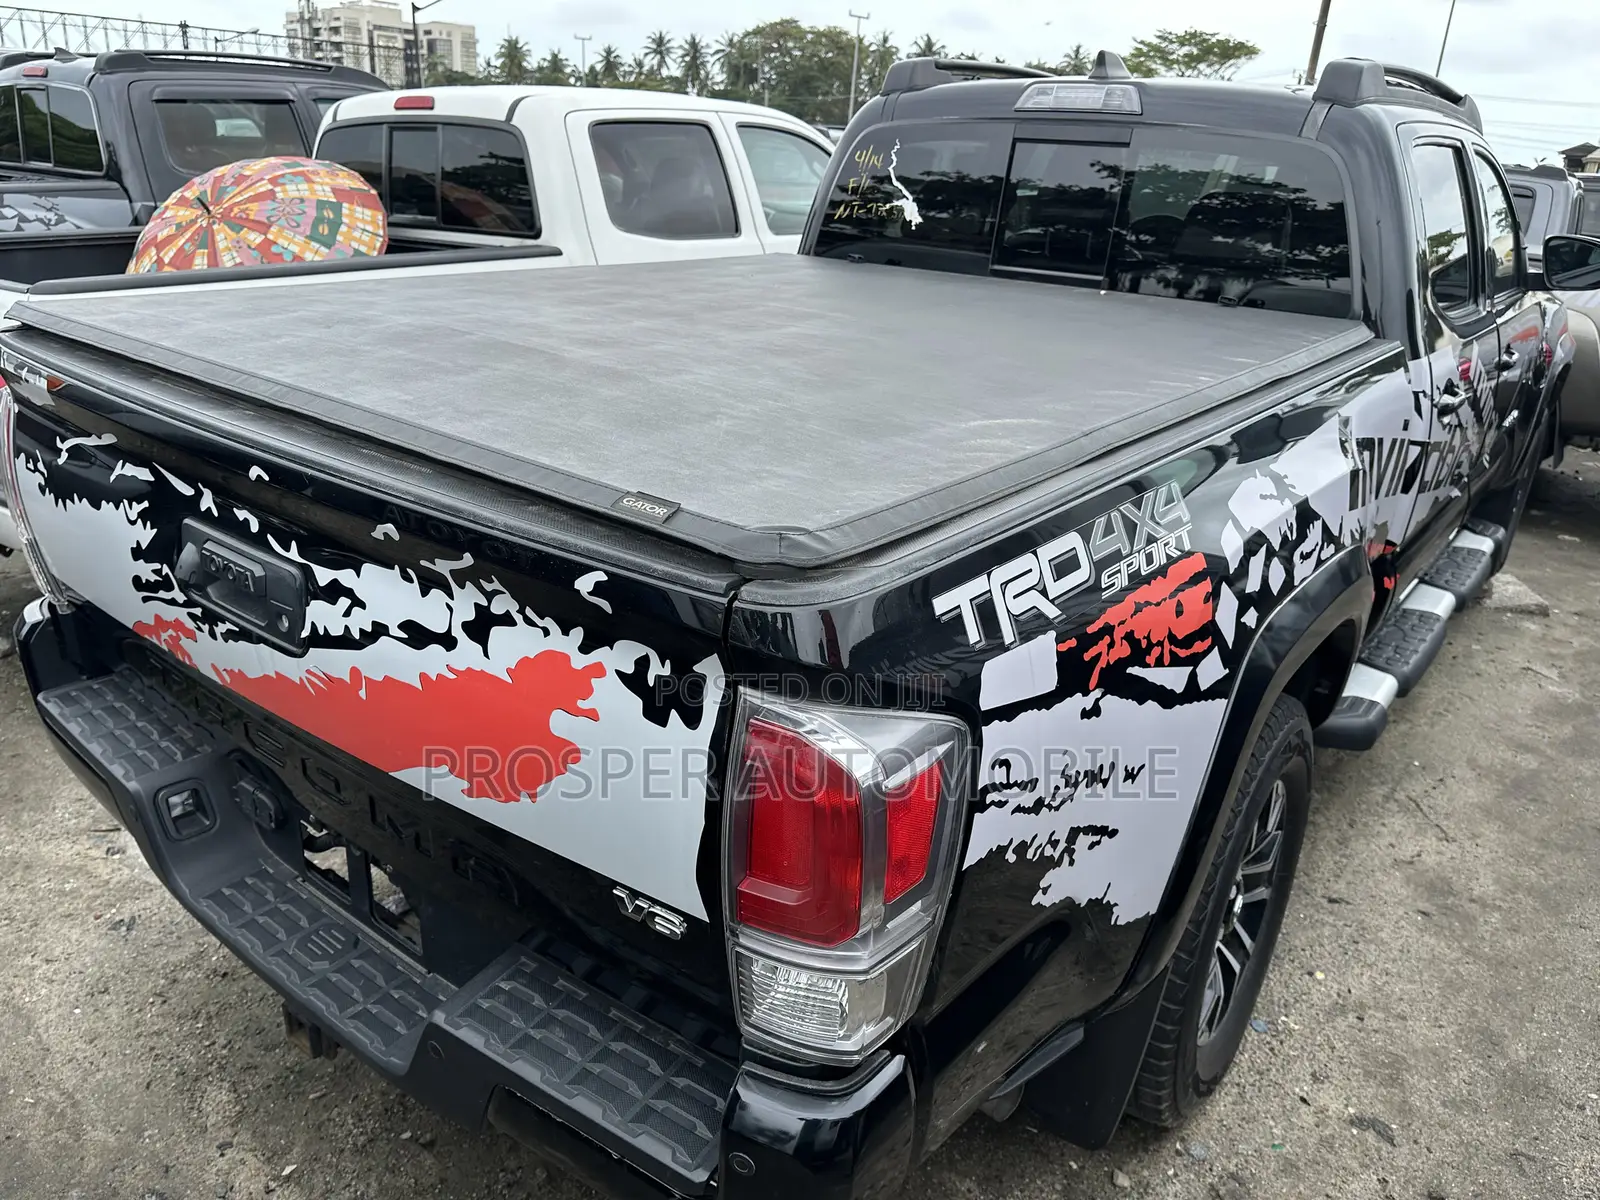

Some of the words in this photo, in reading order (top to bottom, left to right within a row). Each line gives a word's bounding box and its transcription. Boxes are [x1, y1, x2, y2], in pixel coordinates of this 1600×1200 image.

[855, 145, 884, 170] 4/14
[622, 497, 668, 517] GATOR
[1101, 524, 1193, 599] SPORT
[932, 531, 1095, 650] TRD
[612, 886, 687, 940] V6
